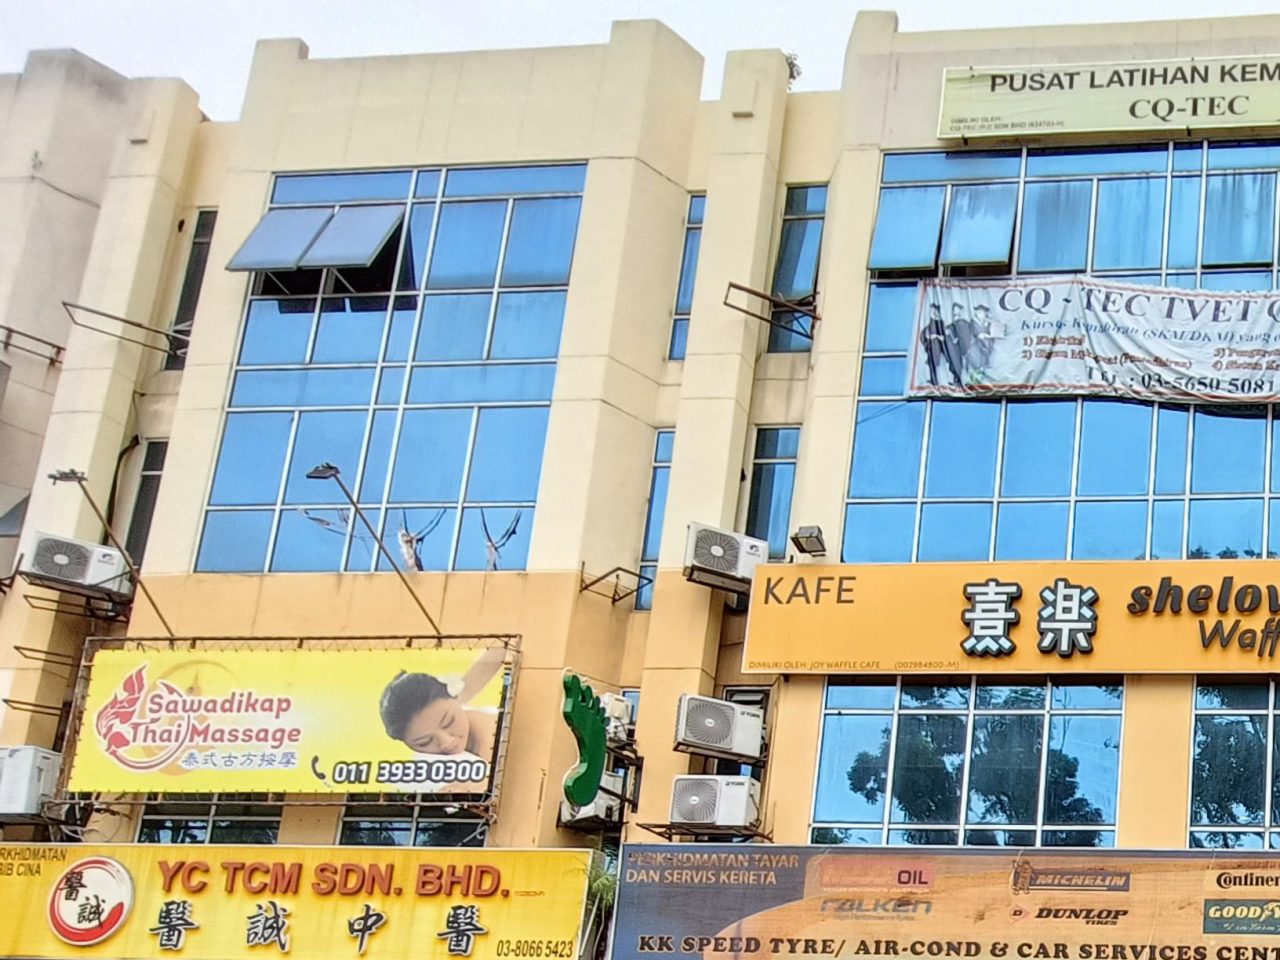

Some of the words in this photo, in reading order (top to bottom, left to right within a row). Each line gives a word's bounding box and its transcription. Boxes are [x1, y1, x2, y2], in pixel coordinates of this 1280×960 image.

[990, 71, 1080, 93] PUSAT
[1089, 64, 1210, 89] LATIHAN
[1128, 95, 1250, 123] CQ-TEC
[999, 287, 1052, 314] CQ
[1080, 286, 1151, 317] TEC
[1161, 296, 1258, 323] TVET
[1235, 331, 1271, 345] yang
[1227, 377, 1275, 394] 5081
[763, 575, 858, 605] KAFE
[749, 661, 782, 669] DIMILIKI
[809, 661, 824, 670] JOY
[826, 661, 858, 669] WAFFLE
[860, 661, 881, 669] CAFE
[147, 690, 292, 720] Sawadikap
[128, 716, 181, 745] Thai
[188, 720, 301, 749] Massage
[180, 752, 298, 769] 泰式古方按摩
[332, 762, 370, 784] 011
[16, 862, 42, 876] CINA
[628, 851, 749, 868] PERKHIDMATAN
[752, 853, 800, 869] TAYAR
[158, 860, 210, 893] YC
[221, 861, 303, 895] TCM
[311, 863, 403, 896] SDN.
[415, 864, 510, 897] BHD.
[625, 869, 661, 883] DAN
[664, 869, 716, 884] SERVIS
[719, 870, 778, 885] KERETA
[897, 870, 929, 885] OIL
[1035, 873, 1127, 887] MICHELIN
[1034, 907, 1129, 920] DUNLOP
[496, 939, 544, 958] 03-8066
[544, 940, 574, 959] 5423
[638, 935, 674, 952] KK
[681, 936, 762, 954] SPEED
[769, 937, 847, 957] TYRE/
[854, 939, 982, 958] AIR-COND
[989, 941, 1009, 957] &
[1017, 942, 1071, 959] CAR
